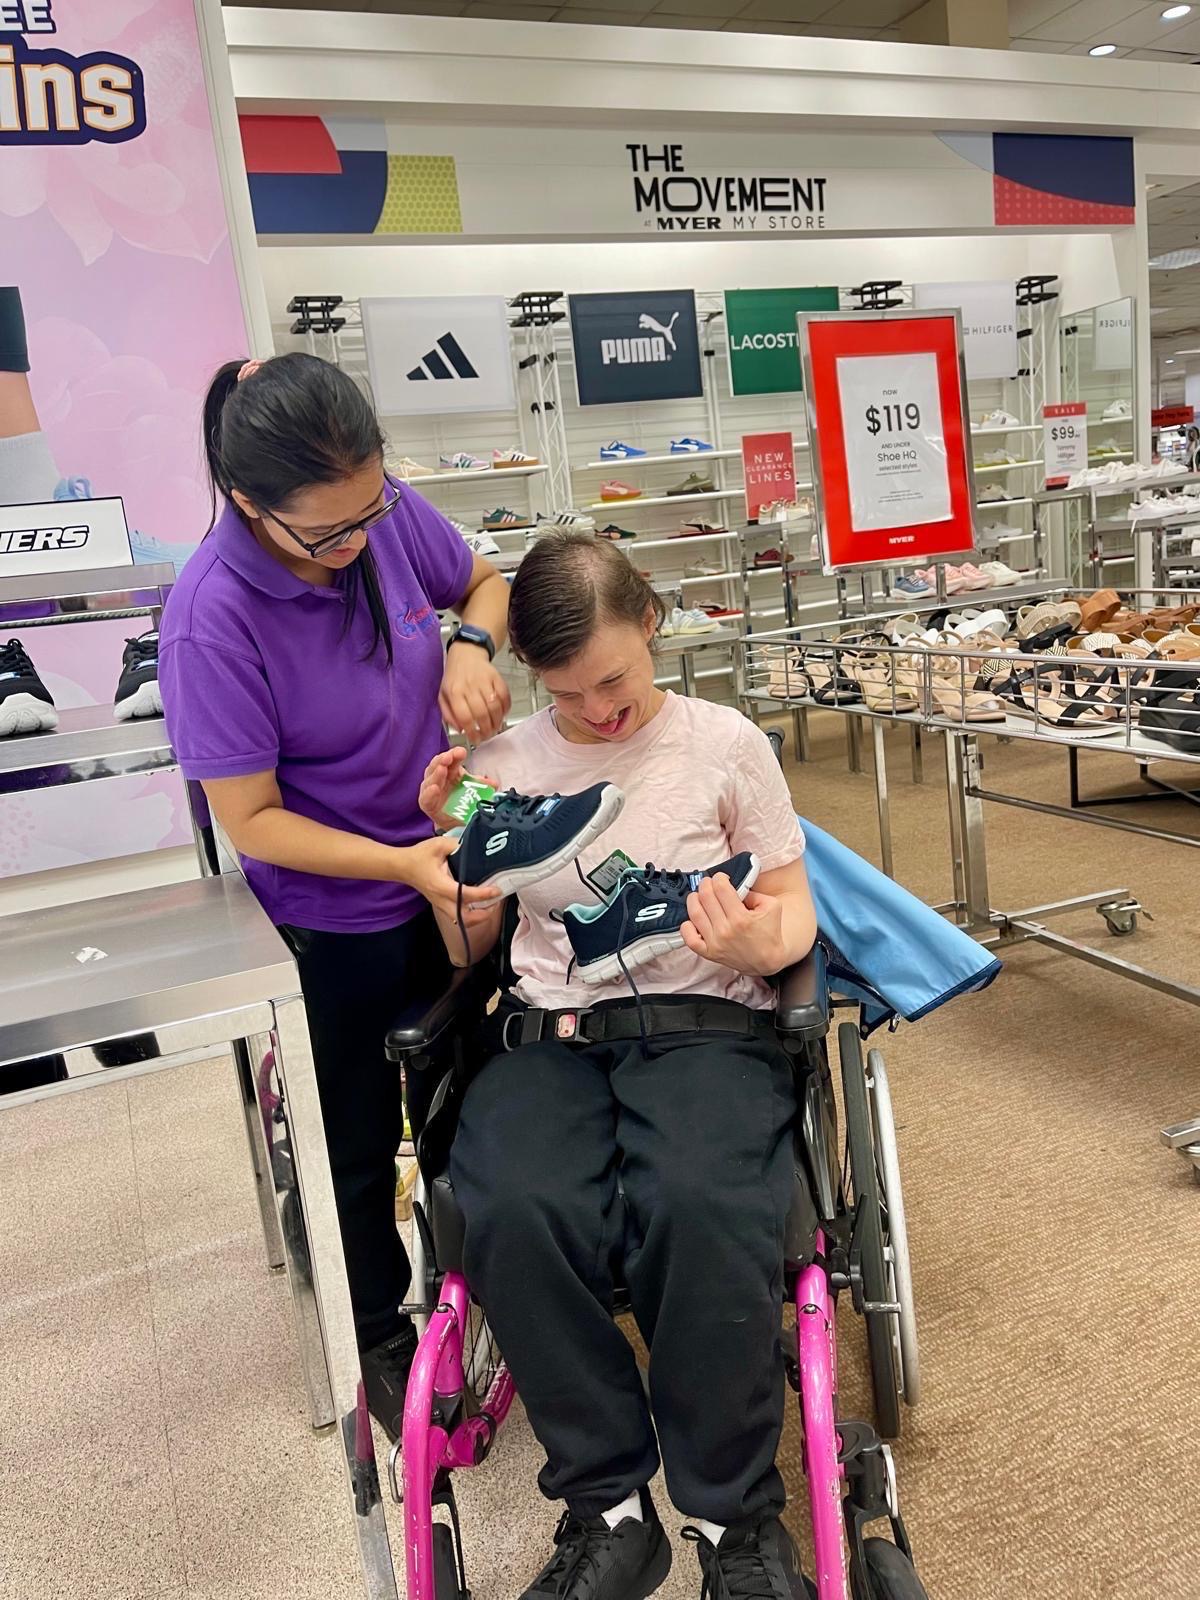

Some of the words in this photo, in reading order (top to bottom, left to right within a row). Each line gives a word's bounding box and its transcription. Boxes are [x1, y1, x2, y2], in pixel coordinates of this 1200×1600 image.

[626, 144, 684, 172] THE
[634, 177, 826, 212] MOVEMENT
[657, 217, 721, 230] MYER
[733, 216, 757, 229] MY
[768, 216, 825, 229] STORE
[972, 324, 1013, 335] HILFIGER
[601, 337, 666, 365] PUMA
[865, 402, 920, 436] $119
[754, 452, 784, 464] NEW
[877, 452, 900, 462] Shoe
[903, 450, 917, 460] HQ
[746, 462, 793, 473] CLEARANCE
[749, 471, 792, 484] LINES
[888, 535, 915, 545] MYER
